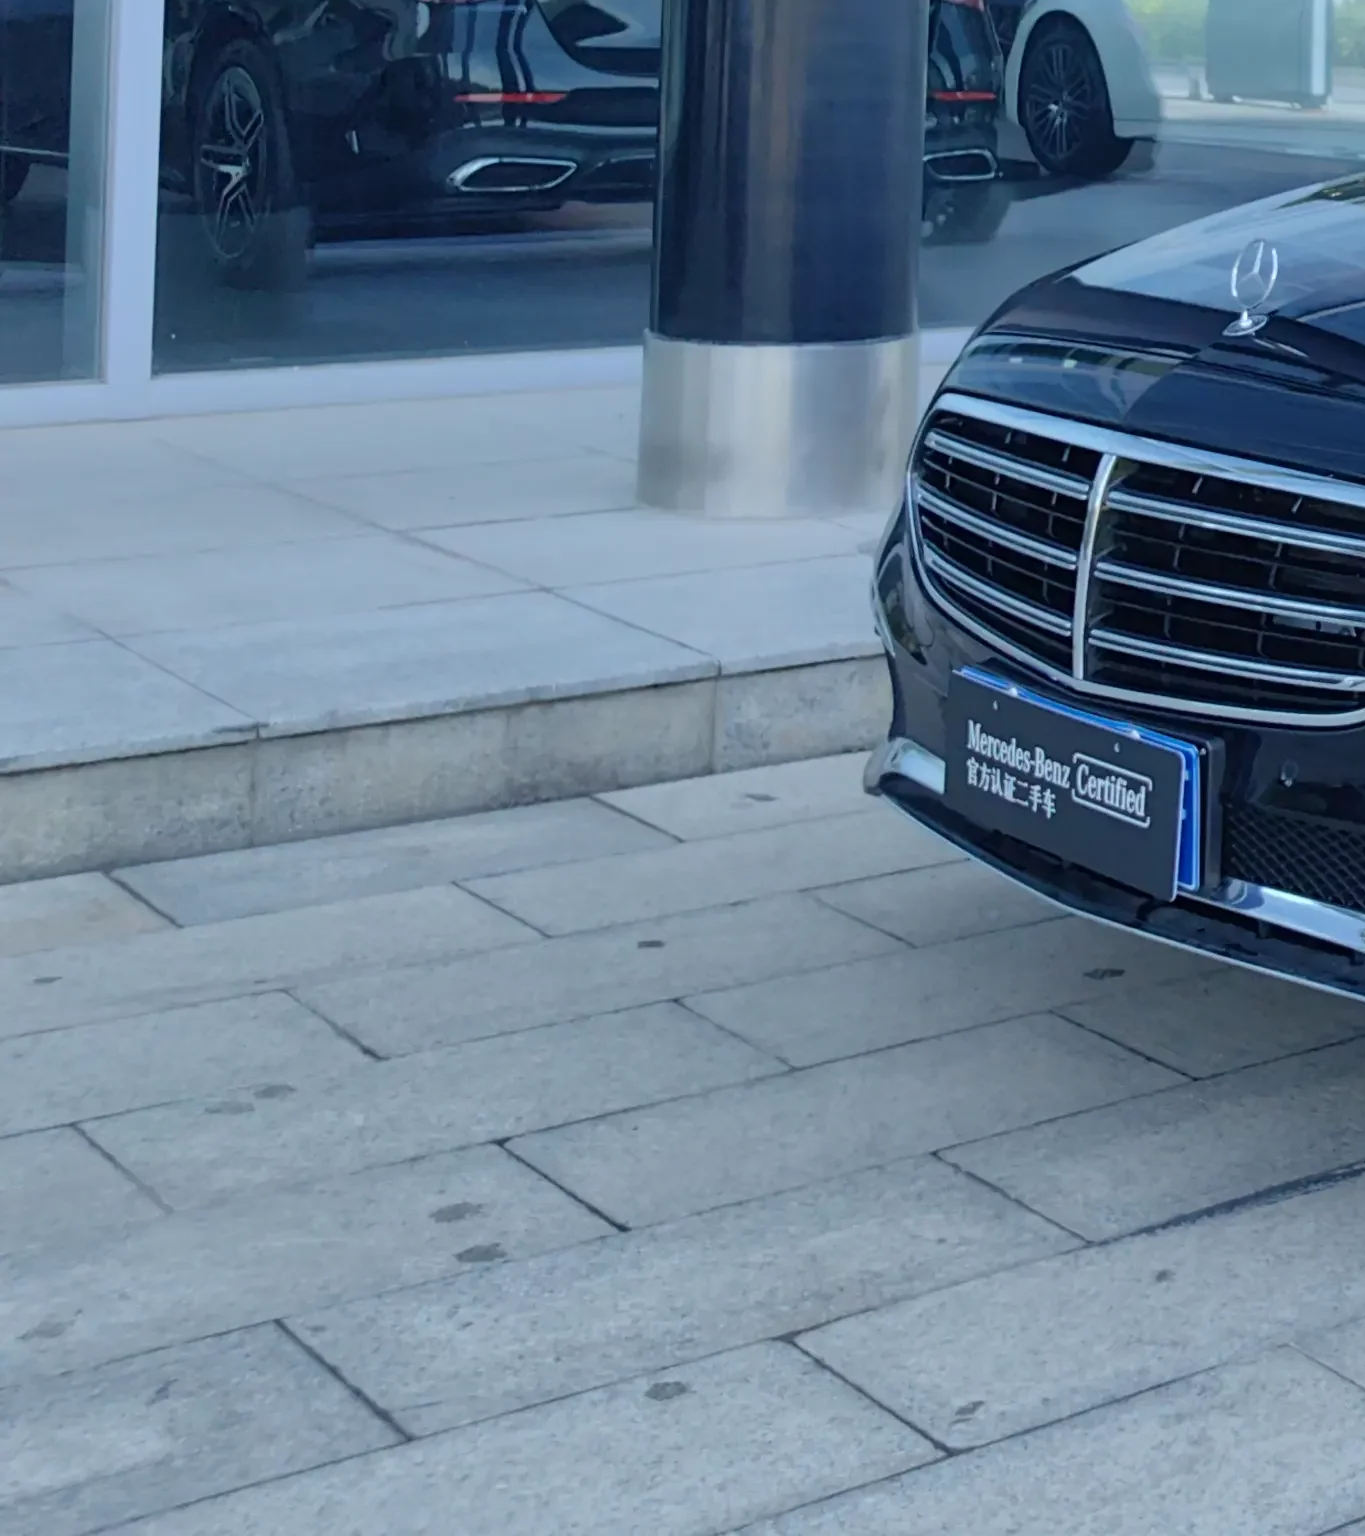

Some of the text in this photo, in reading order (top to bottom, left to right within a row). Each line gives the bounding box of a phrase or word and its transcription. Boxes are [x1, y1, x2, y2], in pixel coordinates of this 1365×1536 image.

[966, 756, 1056, 819] 官方认证二手车
[967, 719, 1147, 817] Mercedes-Benz Certified
